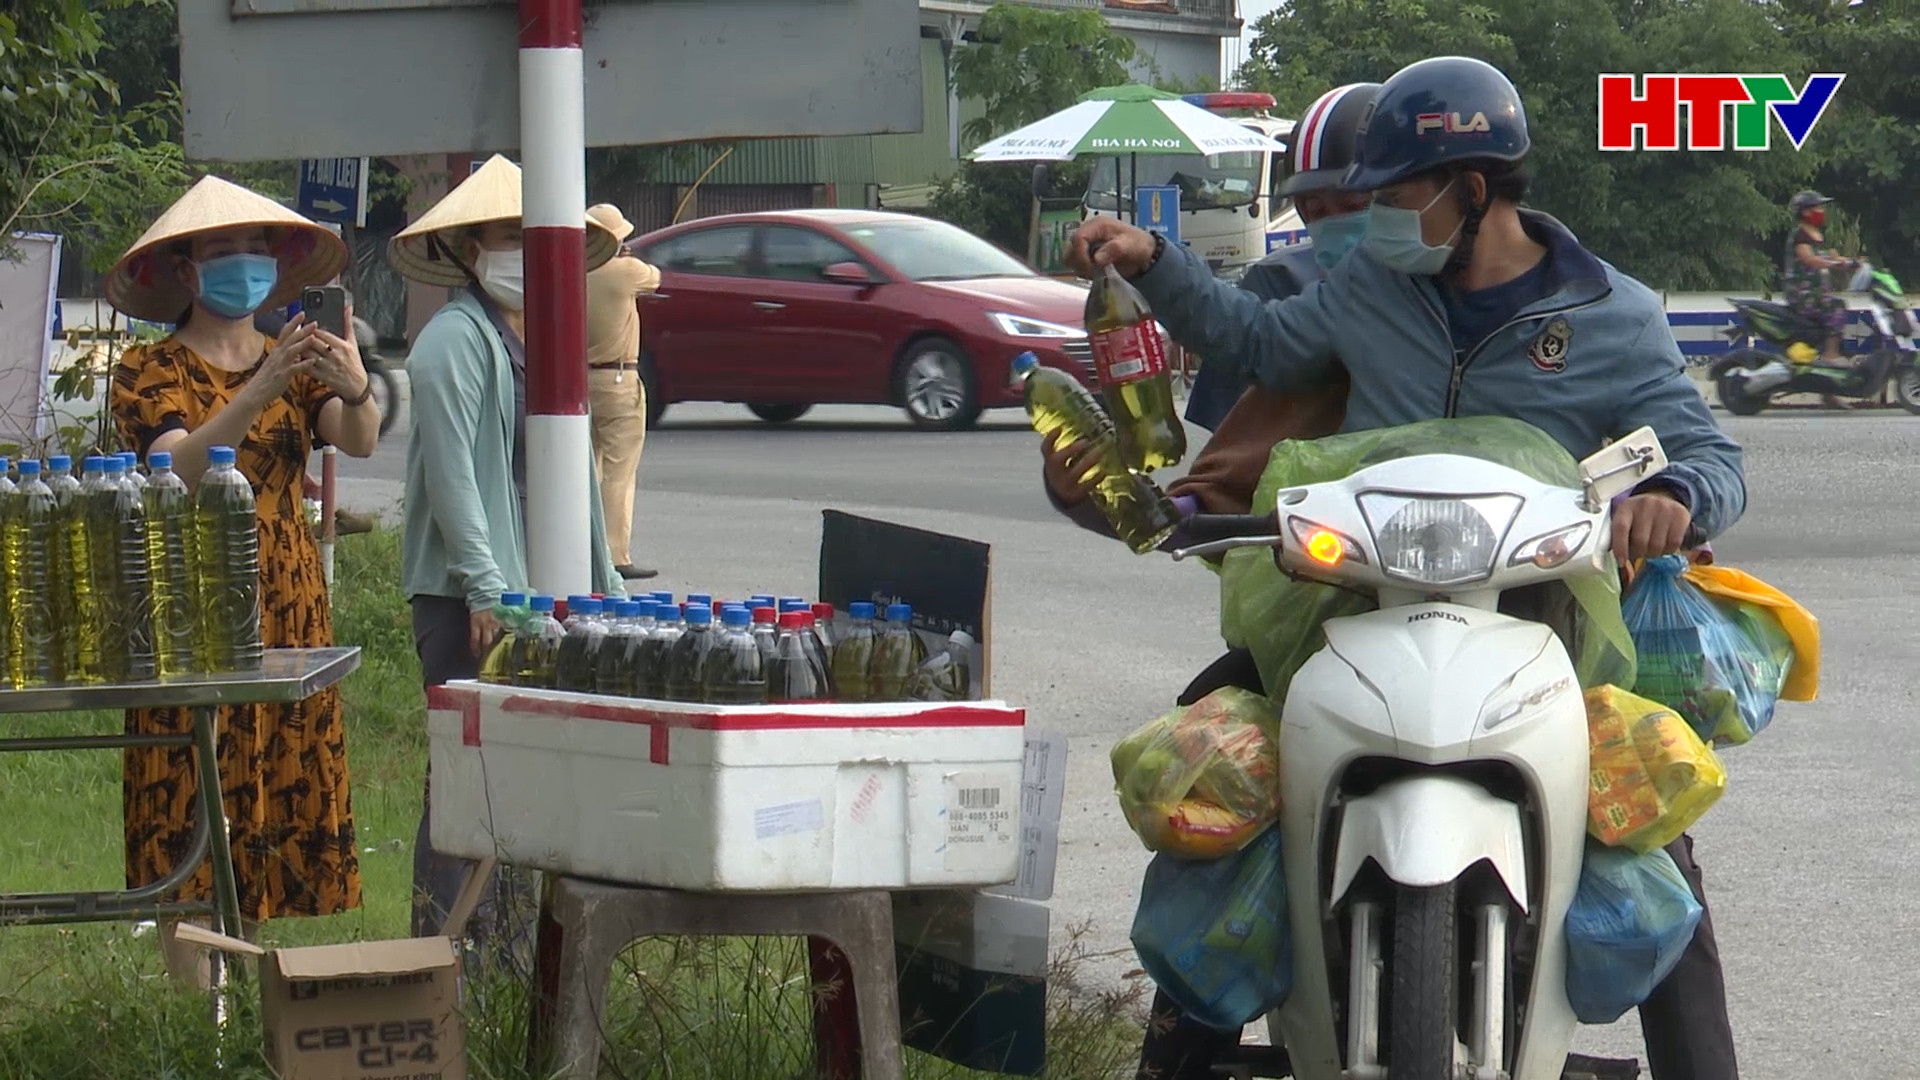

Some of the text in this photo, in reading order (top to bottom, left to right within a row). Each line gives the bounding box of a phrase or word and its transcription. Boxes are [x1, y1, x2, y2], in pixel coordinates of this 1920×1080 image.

[1416, 111, 1491, 136] FILA
[1092, 138, 1120, 147] BIA
[1406, 610, 1470, 626] HONDA
[950, 824, 969, 832] HAN
